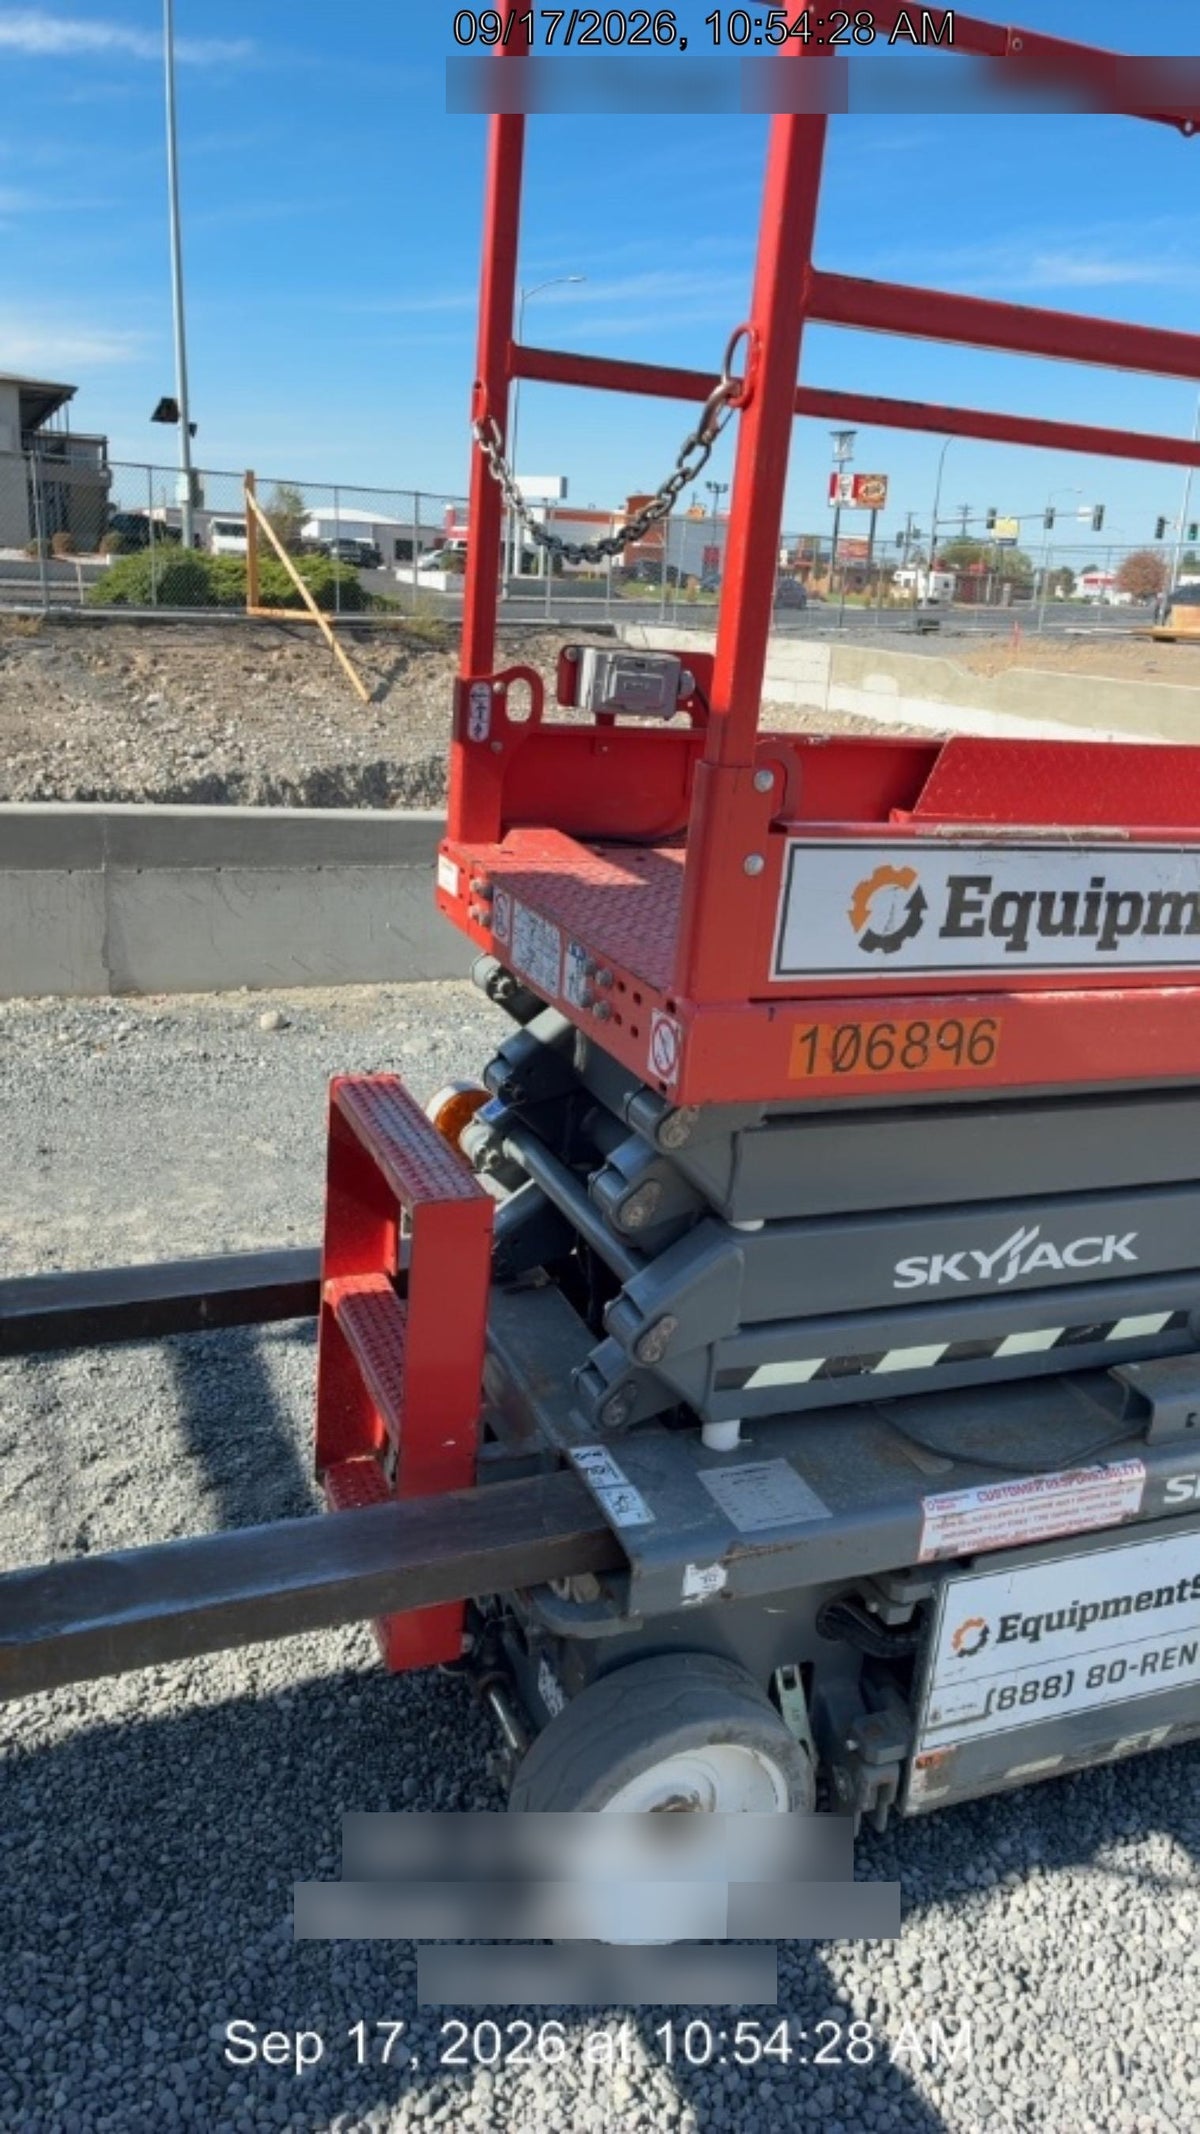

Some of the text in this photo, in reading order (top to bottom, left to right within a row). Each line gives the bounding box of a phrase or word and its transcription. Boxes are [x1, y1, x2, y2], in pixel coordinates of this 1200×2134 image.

[800, 1018, 998, 1075] 106896
[893, 1225, 1140, 1289] SKYJACK
[1164, 1474, 1200, 1504] S
[983, 1641, 1199, 1716] (888) 80-REN
